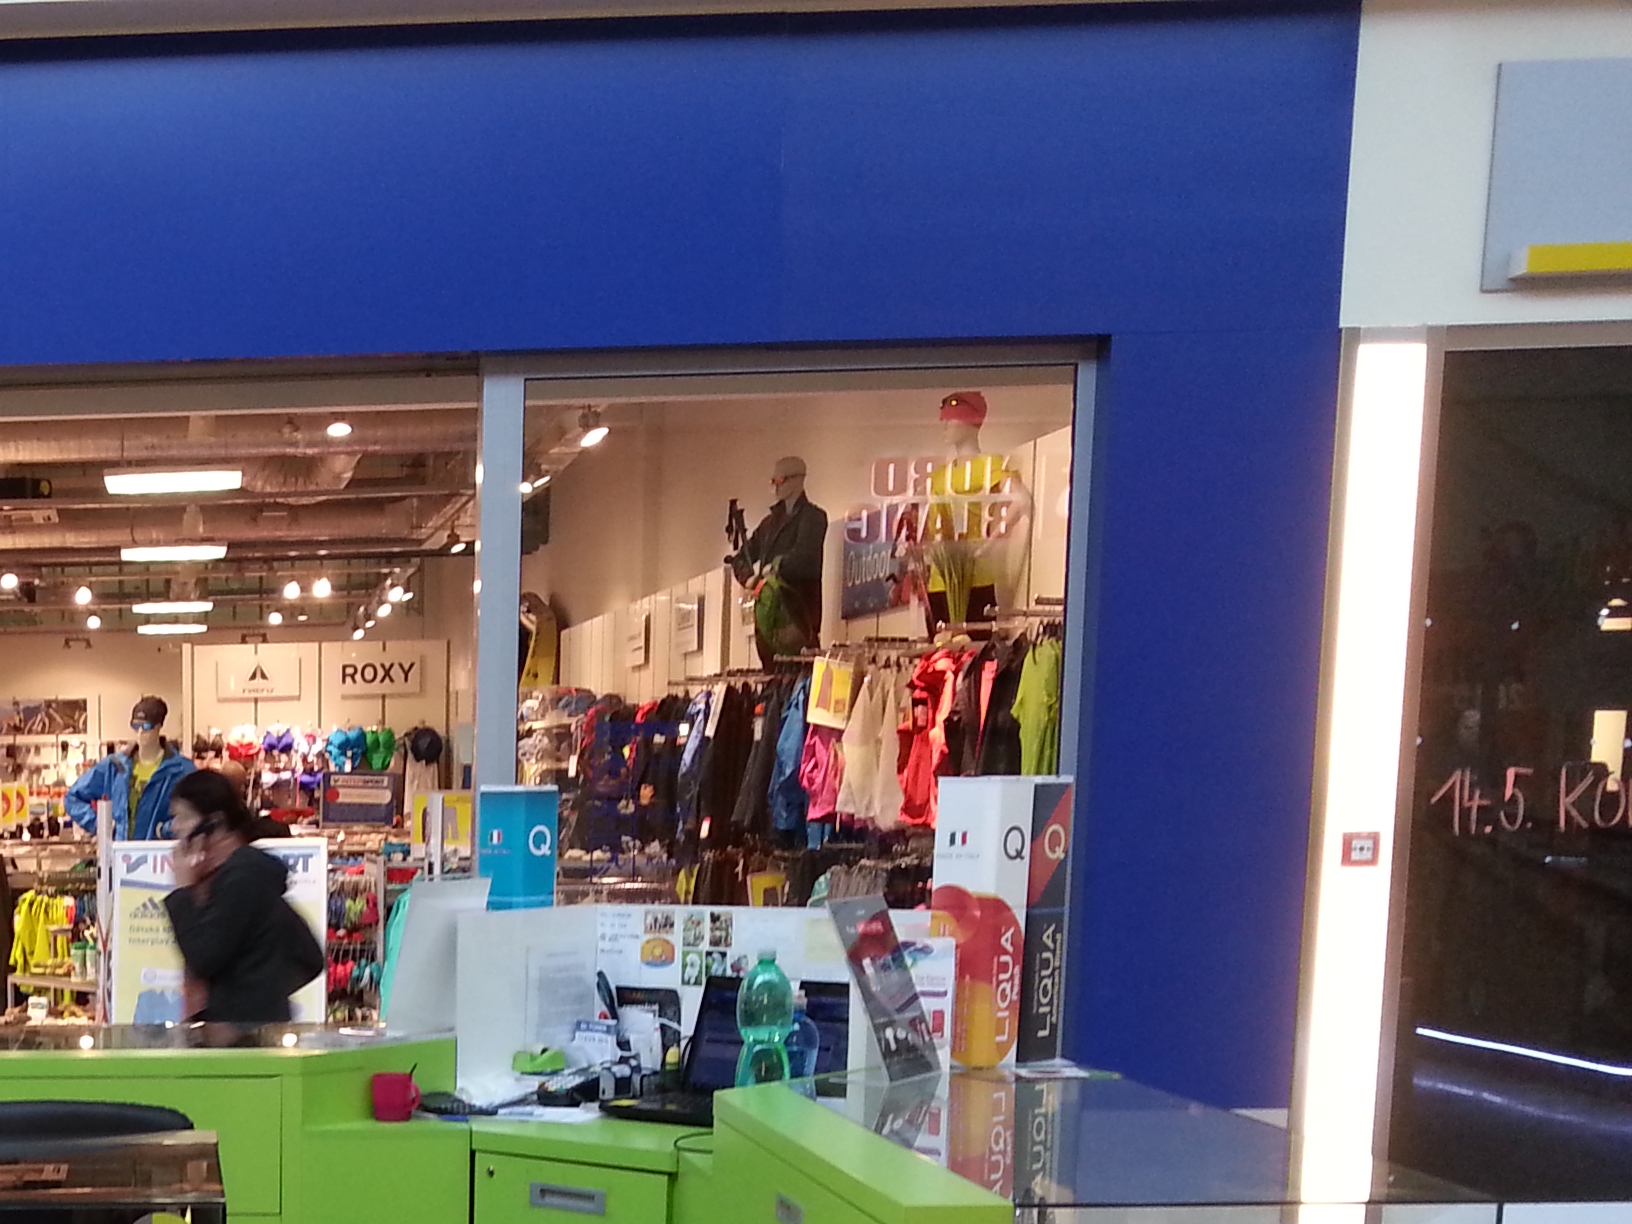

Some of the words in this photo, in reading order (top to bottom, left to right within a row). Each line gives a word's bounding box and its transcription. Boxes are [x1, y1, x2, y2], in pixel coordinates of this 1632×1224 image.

[340, 661, 416, 686] ROXY
[528, 824, 552, 857] Q
[1003, 825, 1026, 861] Q
[1043, 823, 1066, 861] Q
[995, 926, 1016, 1043] LIQUA
[1037, 923, 1056, 1038] LIQUA
